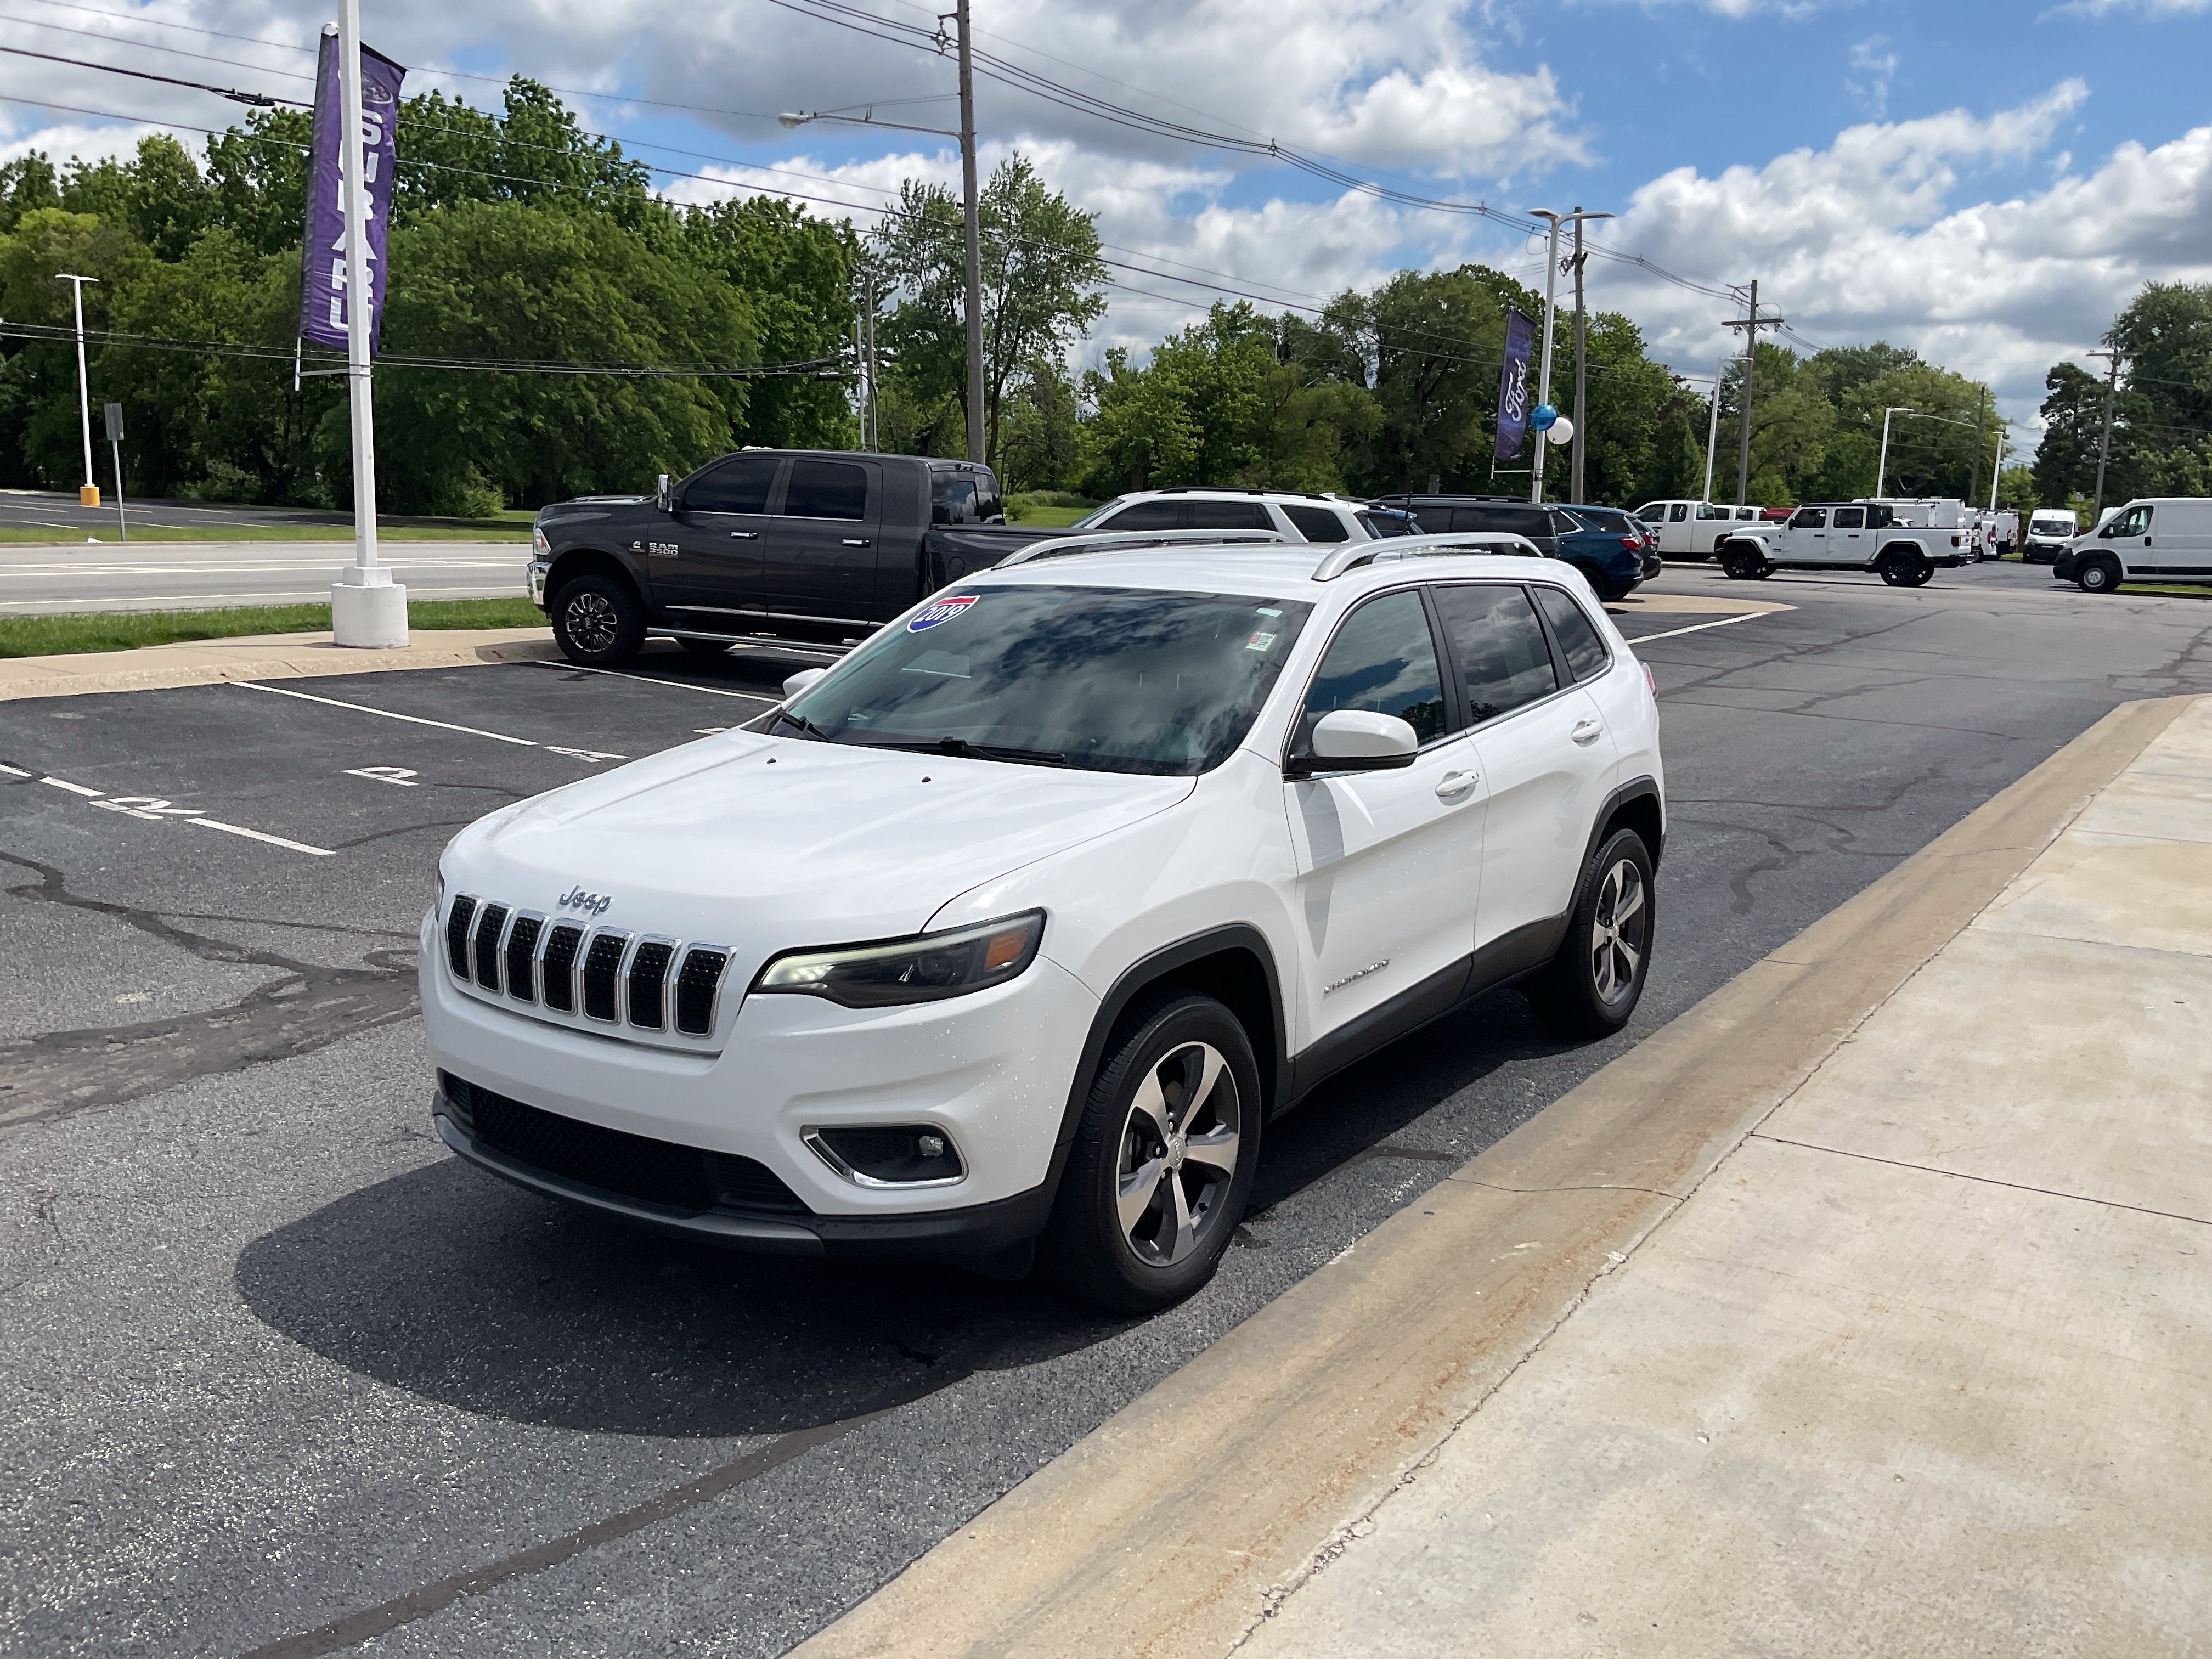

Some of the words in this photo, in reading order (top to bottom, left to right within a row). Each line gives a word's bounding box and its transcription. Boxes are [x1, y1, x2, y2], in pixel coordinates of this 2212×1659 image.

[1505, 358, 1527, 422] Ford
[912, 605, 966, 623] 2019
[560, 885, 613, 916] Jeep
